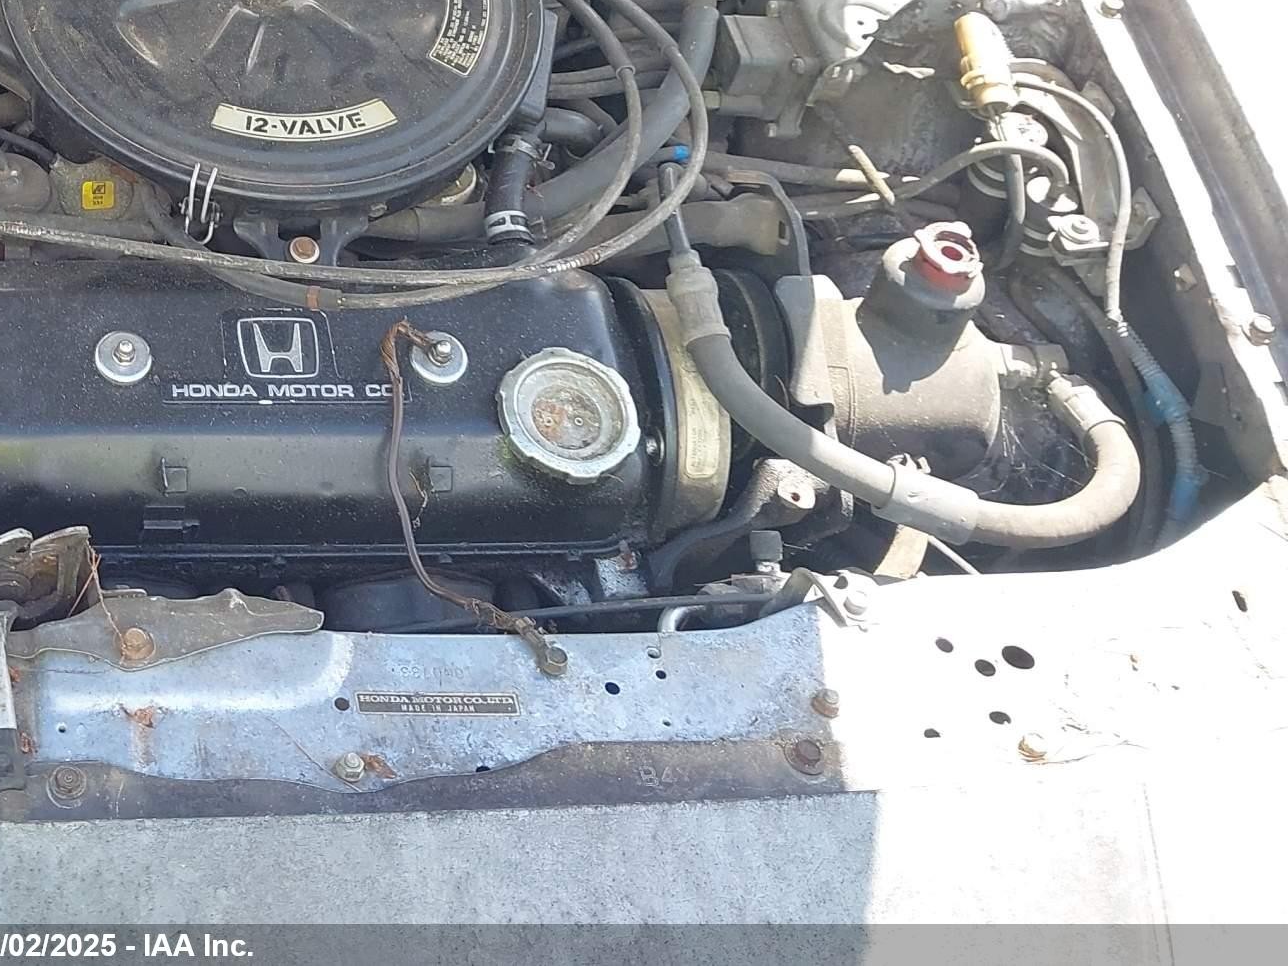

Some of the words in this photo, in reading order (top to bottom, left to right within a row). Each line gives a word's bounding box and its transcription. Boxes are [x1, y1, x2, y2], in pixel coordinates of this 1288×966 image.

[245, 111, 366, 135] 12-VALVE
[172, 384, 258, 398] HONDA
[268, 384, 355, 398] MOTOR
[359, 695, 409, 704] HONDA
[412, 695, 462, 704] MOTOR
